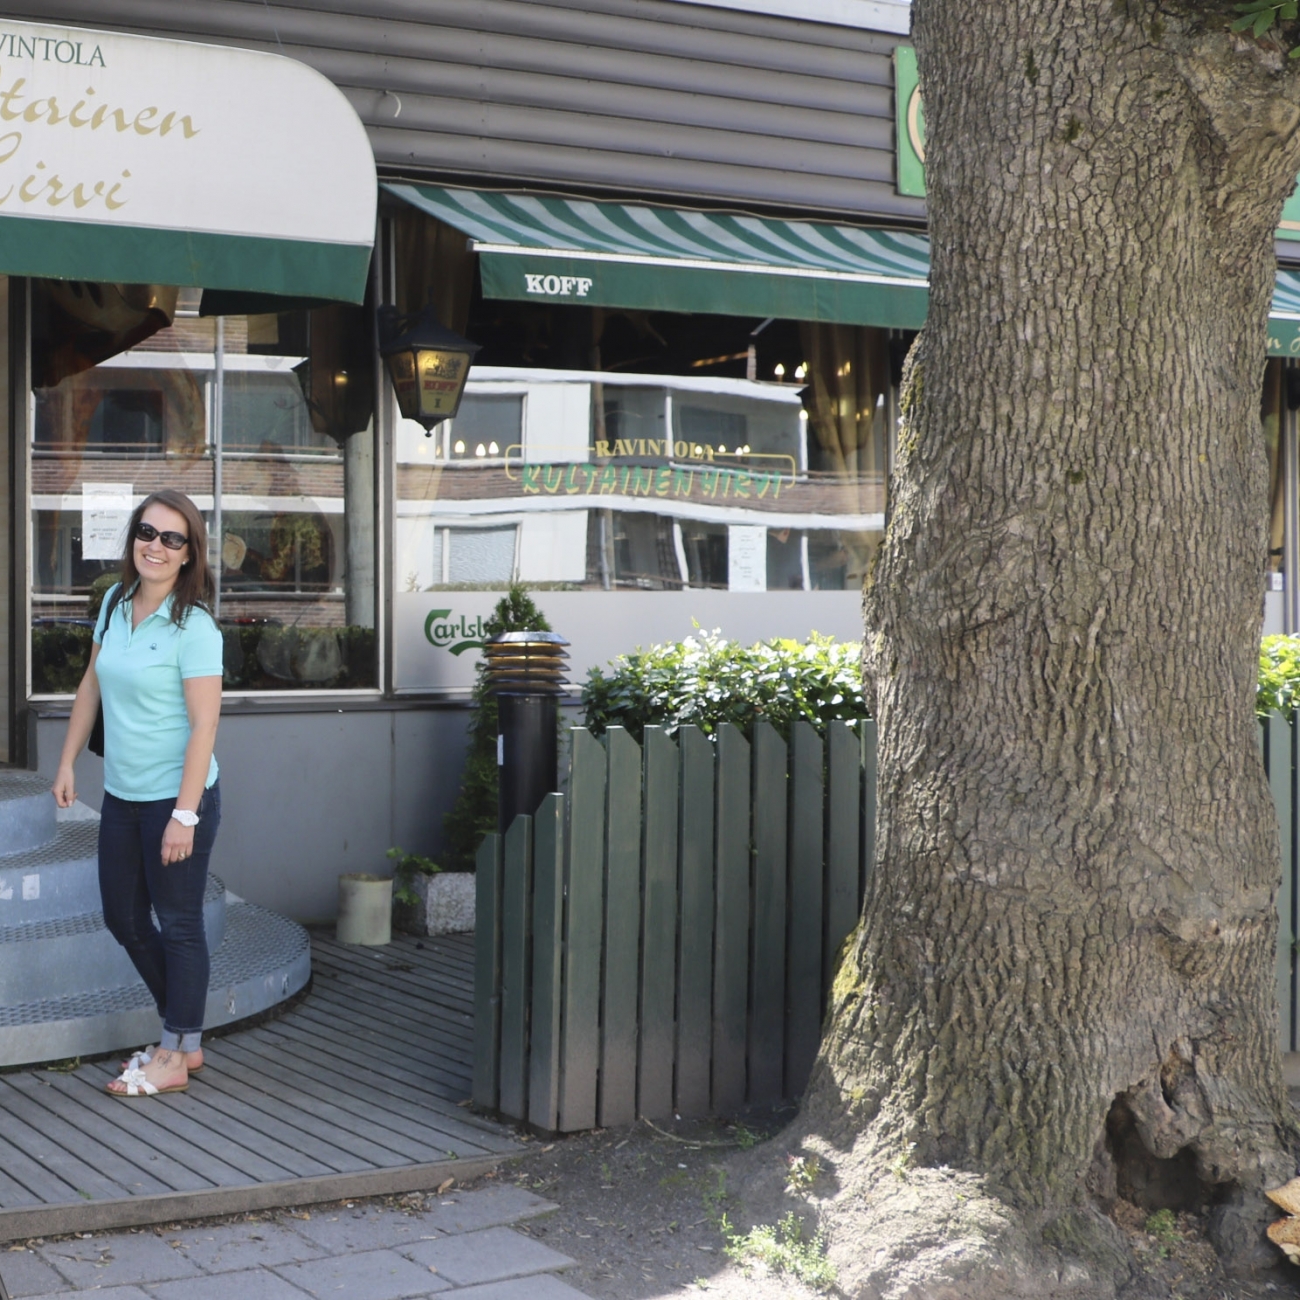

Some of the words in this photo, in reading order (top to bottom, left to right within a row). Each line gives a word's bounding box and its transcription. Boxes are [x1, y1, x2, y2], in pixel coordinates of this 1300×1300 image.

[524, 273, 593, 297] KOFF
[595, 439, 715, 461] RAVINTOLA
[522, 463, 693, 497] KULTAINEN
[701, 466, 783, 499] HIRVI
[424, 609, 488, 648] Carlsb
